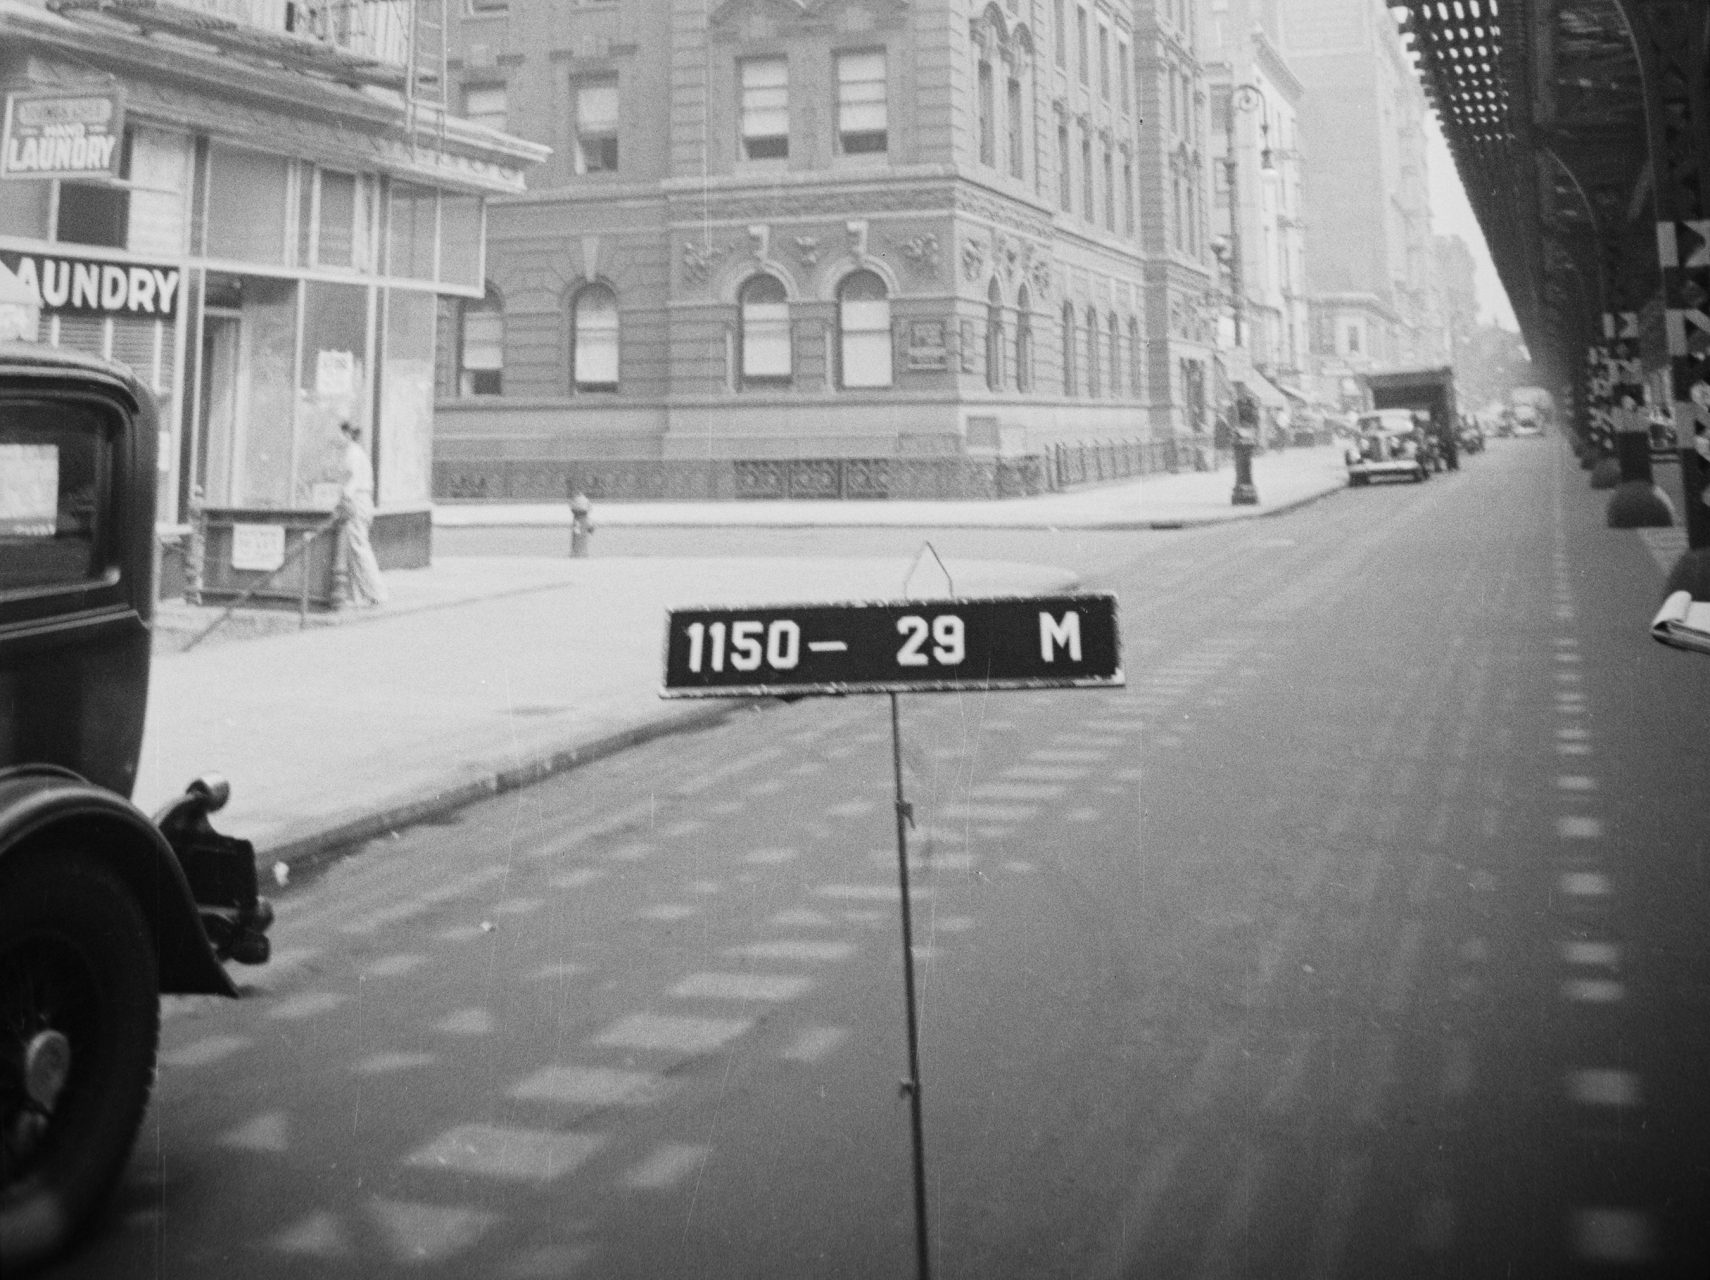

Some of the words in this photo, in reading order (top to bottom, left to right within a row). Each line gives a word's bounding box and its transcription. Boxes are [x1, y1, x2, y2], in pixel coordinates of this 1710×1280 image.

[8, 135, 116, 170] LAUNDRY
[0, 256, 179, 313] AUNDRY
[896, 615, 965, 666] 29
[1039, 611, 1082, 662] M
